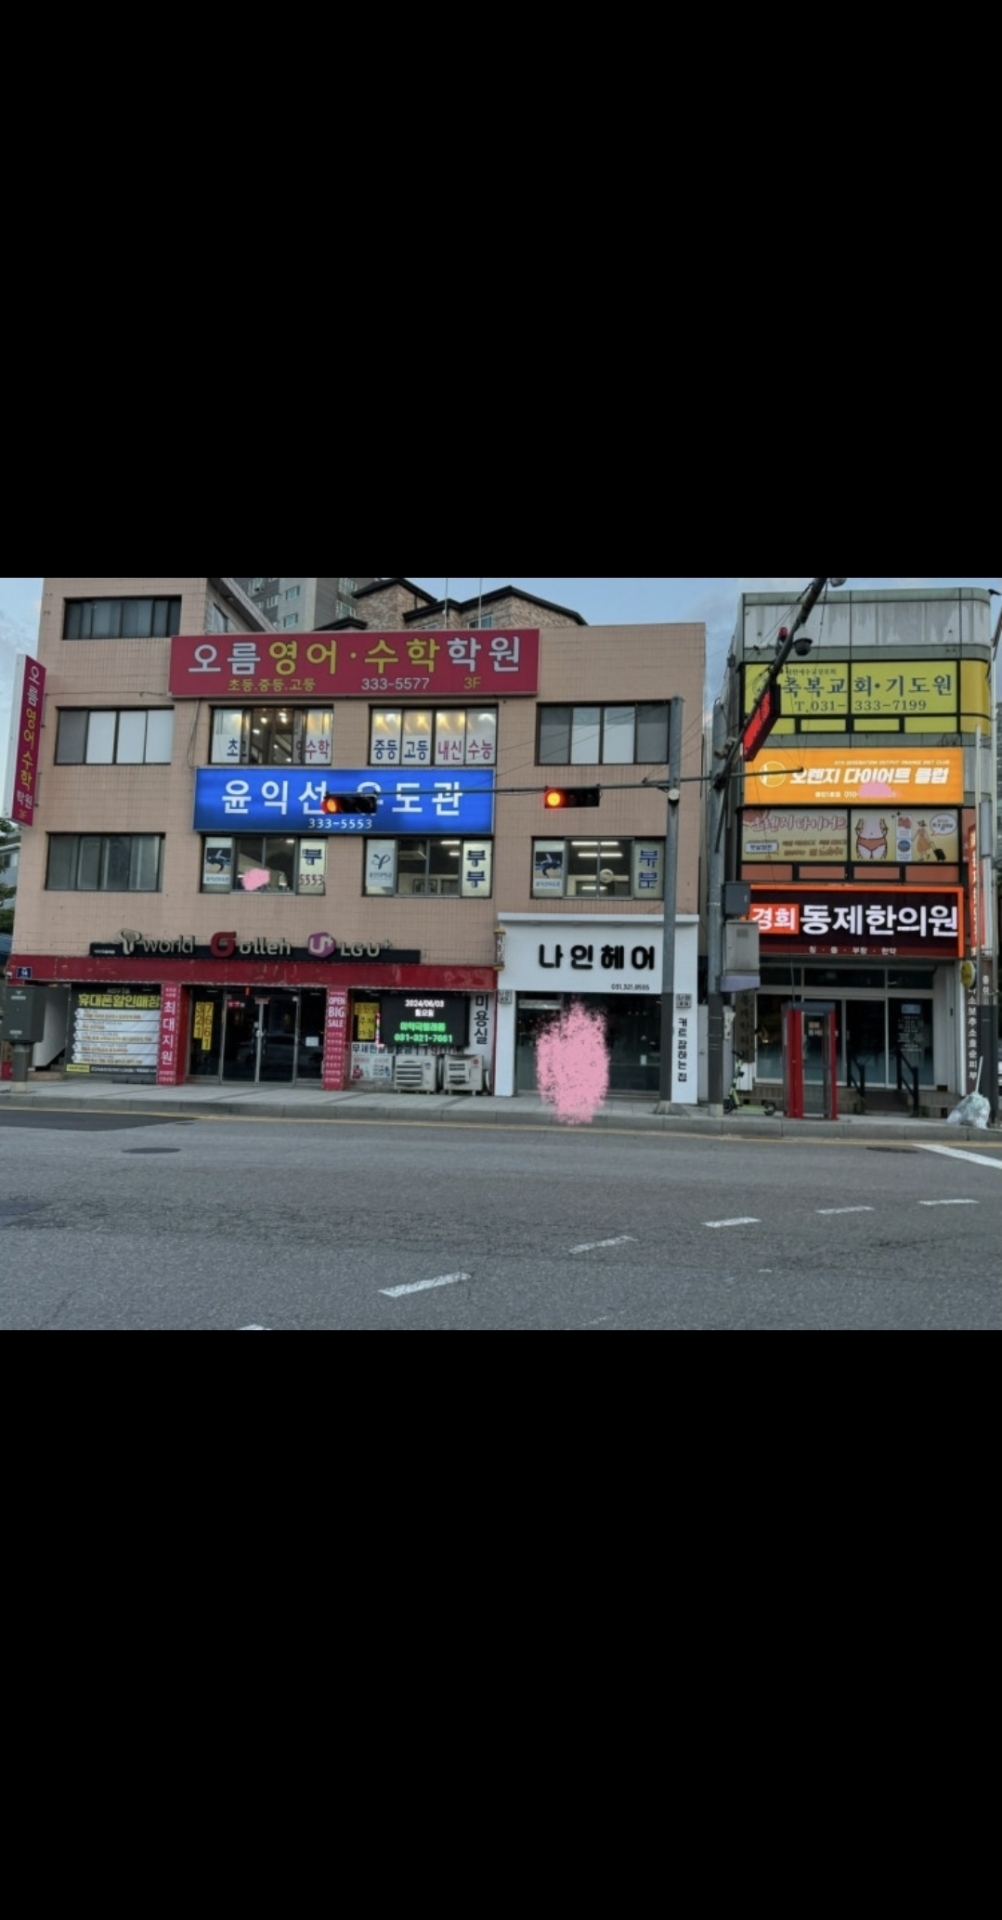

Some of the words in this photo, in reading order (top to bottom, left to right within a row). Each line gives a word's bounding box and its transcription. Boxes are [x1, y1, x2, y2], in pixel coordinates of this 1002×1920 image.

[362, 677, 430, 690] 333-5577
[464, 677, 481, 689] 3F
[373, 739, 398, 760] 중등
[404, 739, 429, 760] 고등
[437, 740, 462, 761] 내신
[467, 739, 493, 760] 수능
[790, 767, 841, 785] 오렌지
[843, 767, 911, 785] 다이어트
[915, 767, 949, 785] 클럽
[222, 779, 327, 815] 윤익선
[308, 817, 373, 829] 333-5553
[800, 905, 959, 937] 동제한의원
[143, 934, 195, 953] world
[539, 944, 655, 970] 나인헤어
[328, 1007, 345, 1018] BIG
[474, 994, 489, 1045] 미용실
[161, 1000, 176, 1065] 최대지원
[327, 1019, 344, 1028] SALE
